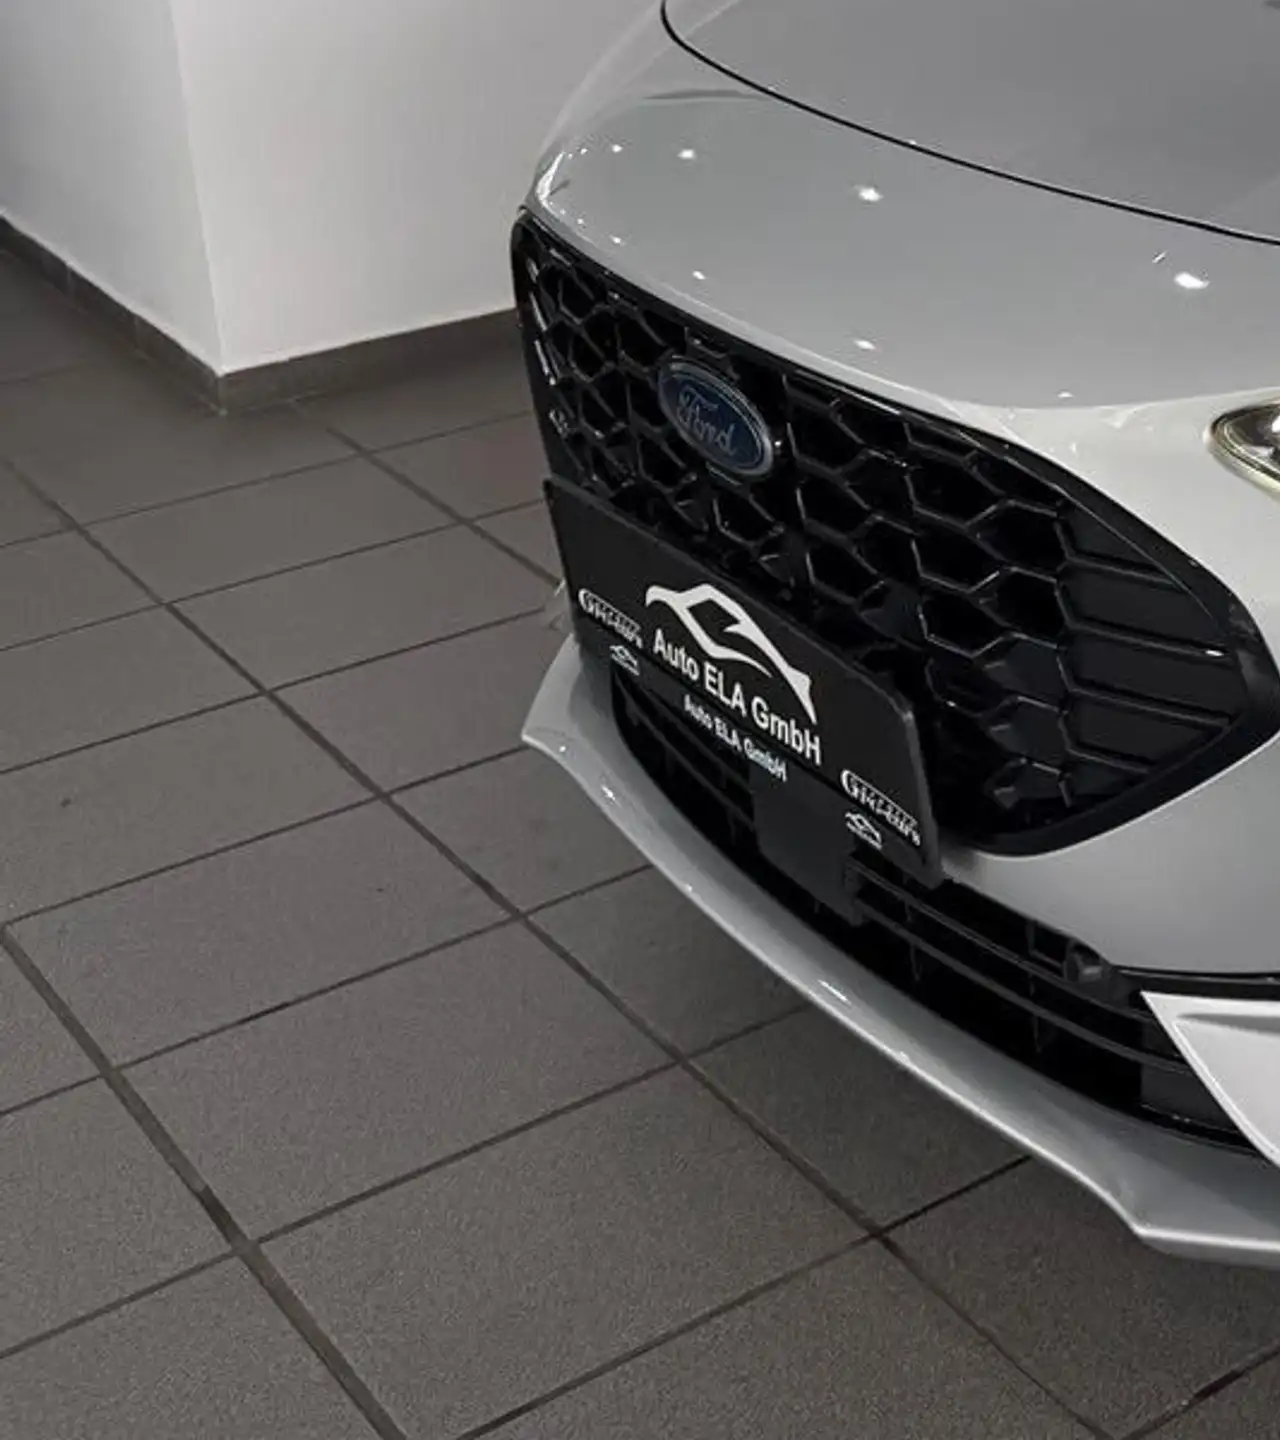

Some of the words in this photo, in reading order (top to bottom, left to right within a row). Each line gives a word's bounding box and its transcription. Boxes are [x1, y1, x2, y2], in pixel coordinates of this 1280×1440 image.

[677, 383, 738, 457] Ford
[652, 627, 700, 682] Auto
[704, 661, 748, 718] ELA
[751, 695, 822, 766] GmbH
[684, 693, 713, 731] Auto
[714, 715, 743, 753] ELA
[743, 737, 788, 783] GmbH
